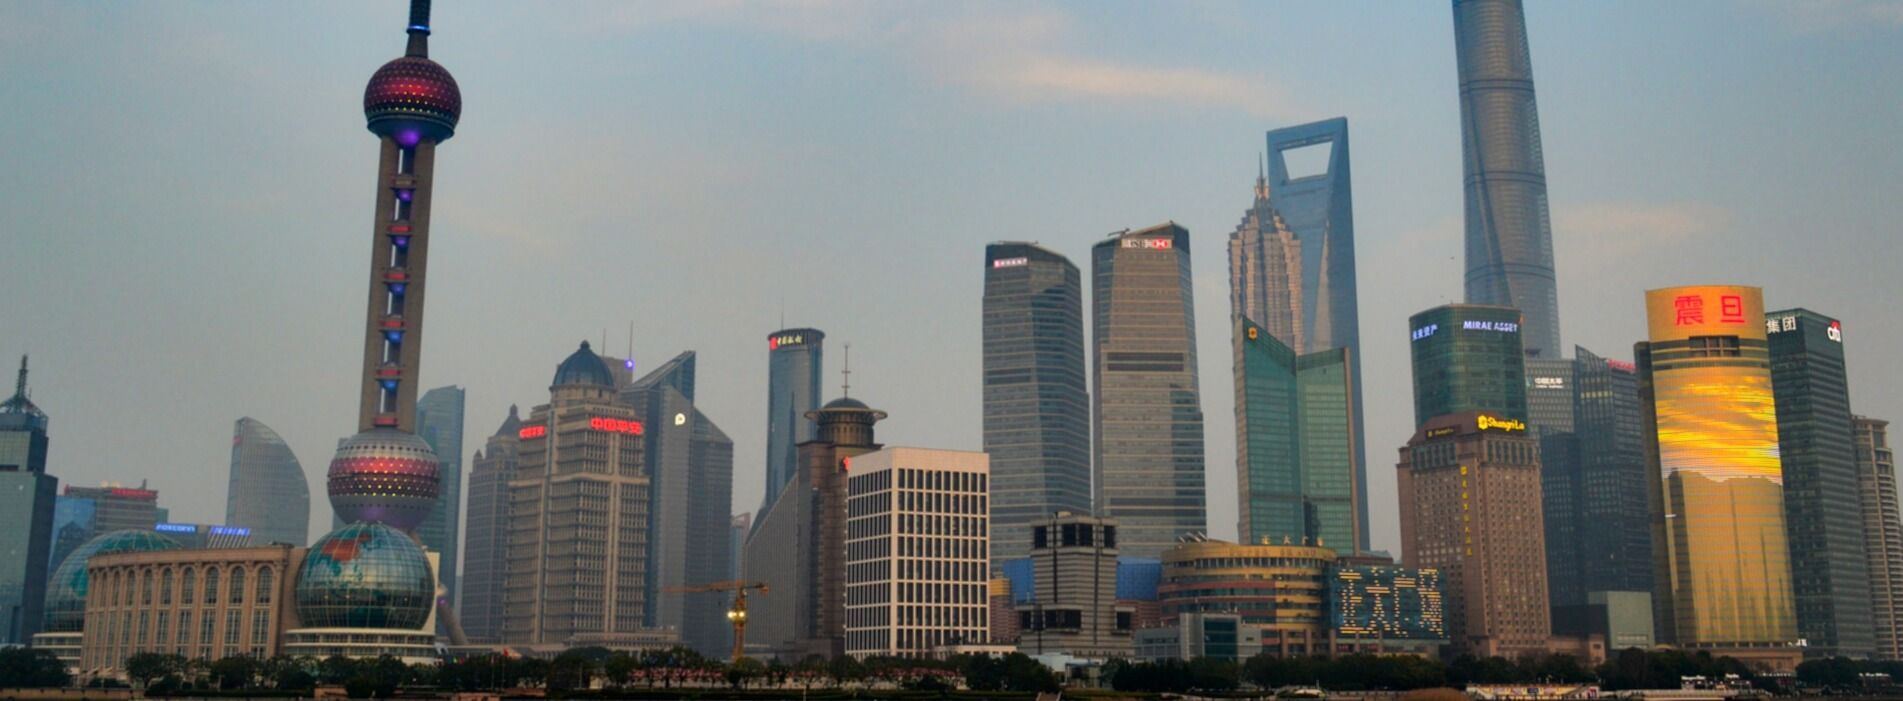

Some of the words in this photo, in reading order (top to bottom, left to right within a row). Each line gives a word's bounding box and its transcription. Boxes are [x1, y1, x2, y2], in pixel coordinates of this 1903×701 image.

[1674, 295, 1745, 326] 震旦
[1463, 320, 1492, 330] MIRAE
[1494, 322, 1518, 332] ASSET
[1766, 316, 1797, 334] 集团
